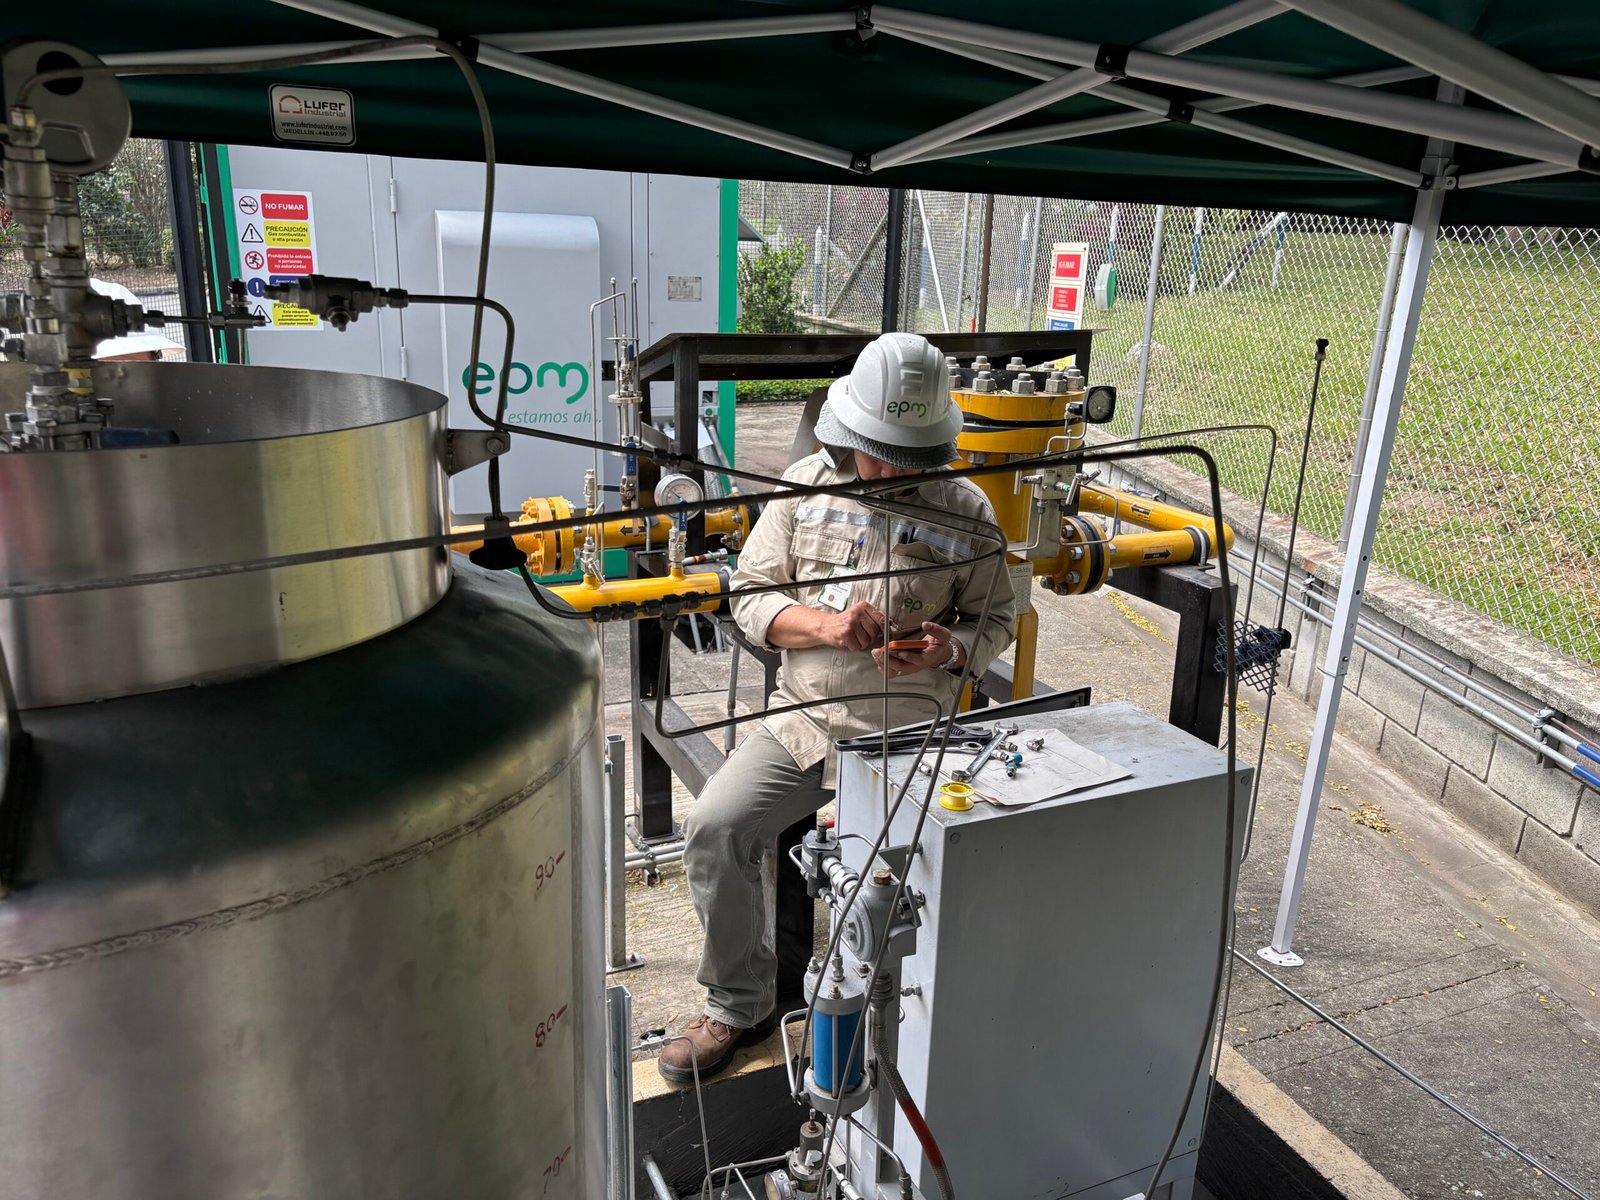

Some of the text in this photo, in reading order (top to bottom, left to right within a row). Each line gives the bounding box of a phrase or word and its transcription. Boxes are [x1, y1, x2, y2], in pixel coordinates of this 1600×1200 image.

[304, 108, 347, 118] Industrial
[278, 203, 305, 211] FUMAR
[265, 225, 308, 233] PRECAUCIÓN
[462, 361, 589, 410] epm
[507, 409, 569, 424] estamos
[886, 400, 927, 419] epm
[904, 597, 937, 617] epm
